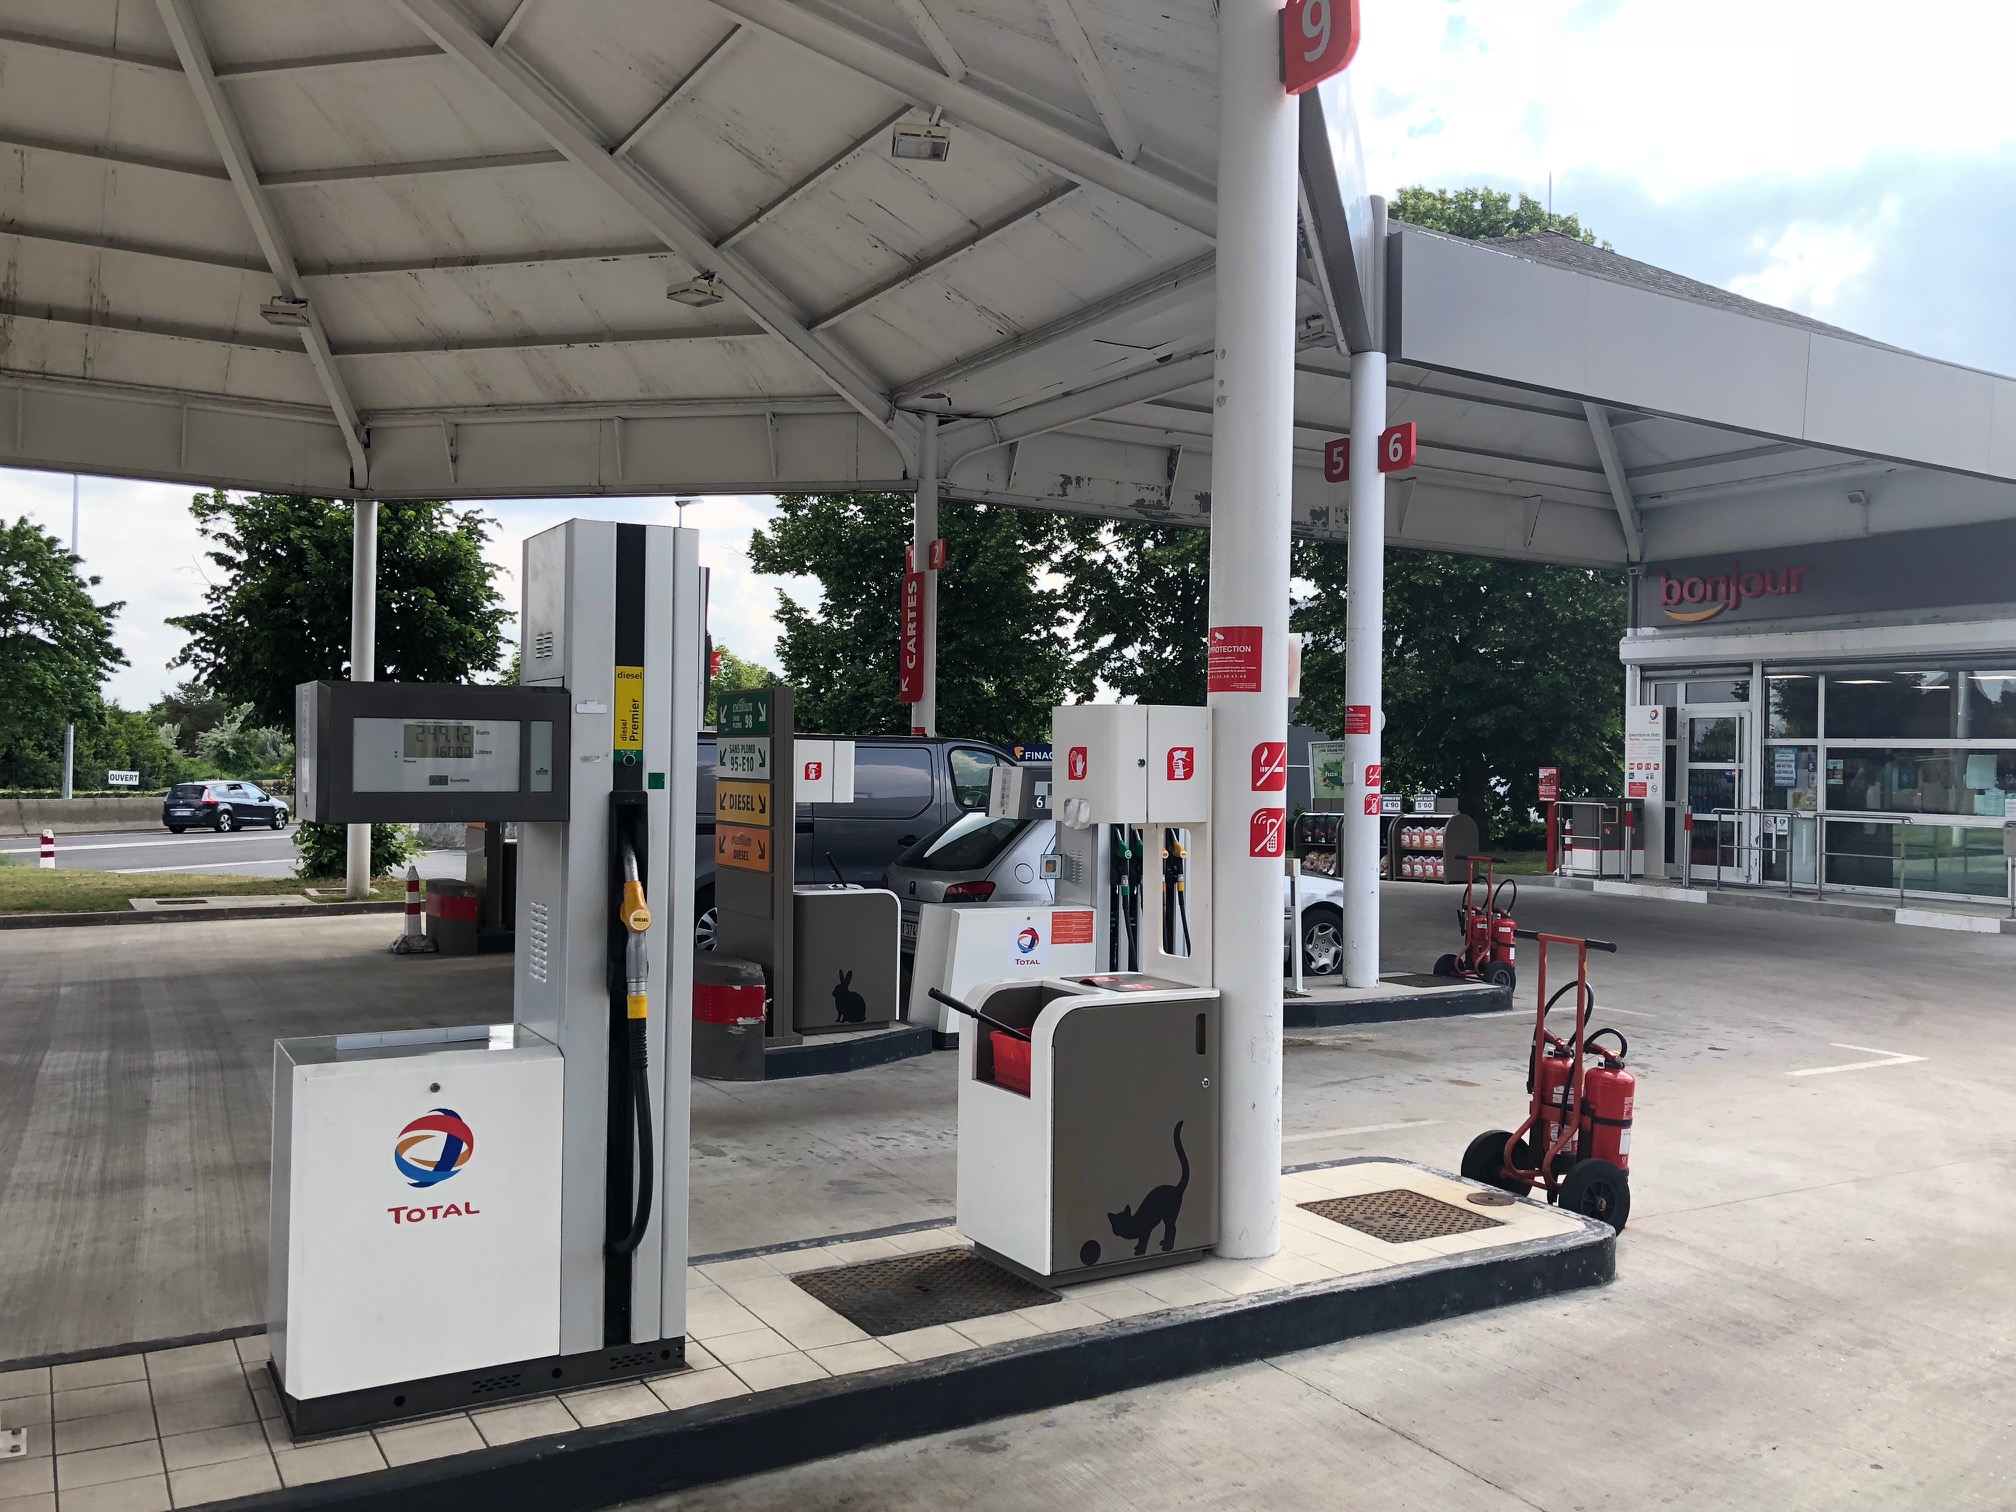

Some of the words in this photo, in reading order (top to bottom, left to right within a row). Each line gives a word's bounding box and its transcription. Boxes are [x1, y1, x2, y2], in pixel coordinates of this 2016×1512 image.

[1302, 0, 1331, 62] 9
[1389, 432, 1402, 463] 6
[1332, 445, 1344, 475] 5
[933, 544, 940, 564] 2
[1659, 562, 1810, 611] bonjour
[906, 580, 917, 669] CARTES
[617, 671, 643, 680] diesel
[629, 698, 640, 742] Premier
[744, 714, 753, 728] 98
[620, 719, 628, 742] diesel
[729, 744, 740, 754] SANS
[740, 744, 755, 754] PLOMB
[730, 757, 754, 772] 95-E10
[109, 774, 138, 782] OUVERT
[729, 793, 755, 811] DIESEL
[1036, 796, 1043, 808] 6
[734, 849, 749, 861] DIESEL
[1015, 958, 1041, 966] TOTAL
[387, 1201, 480, 1224] TOTAL
